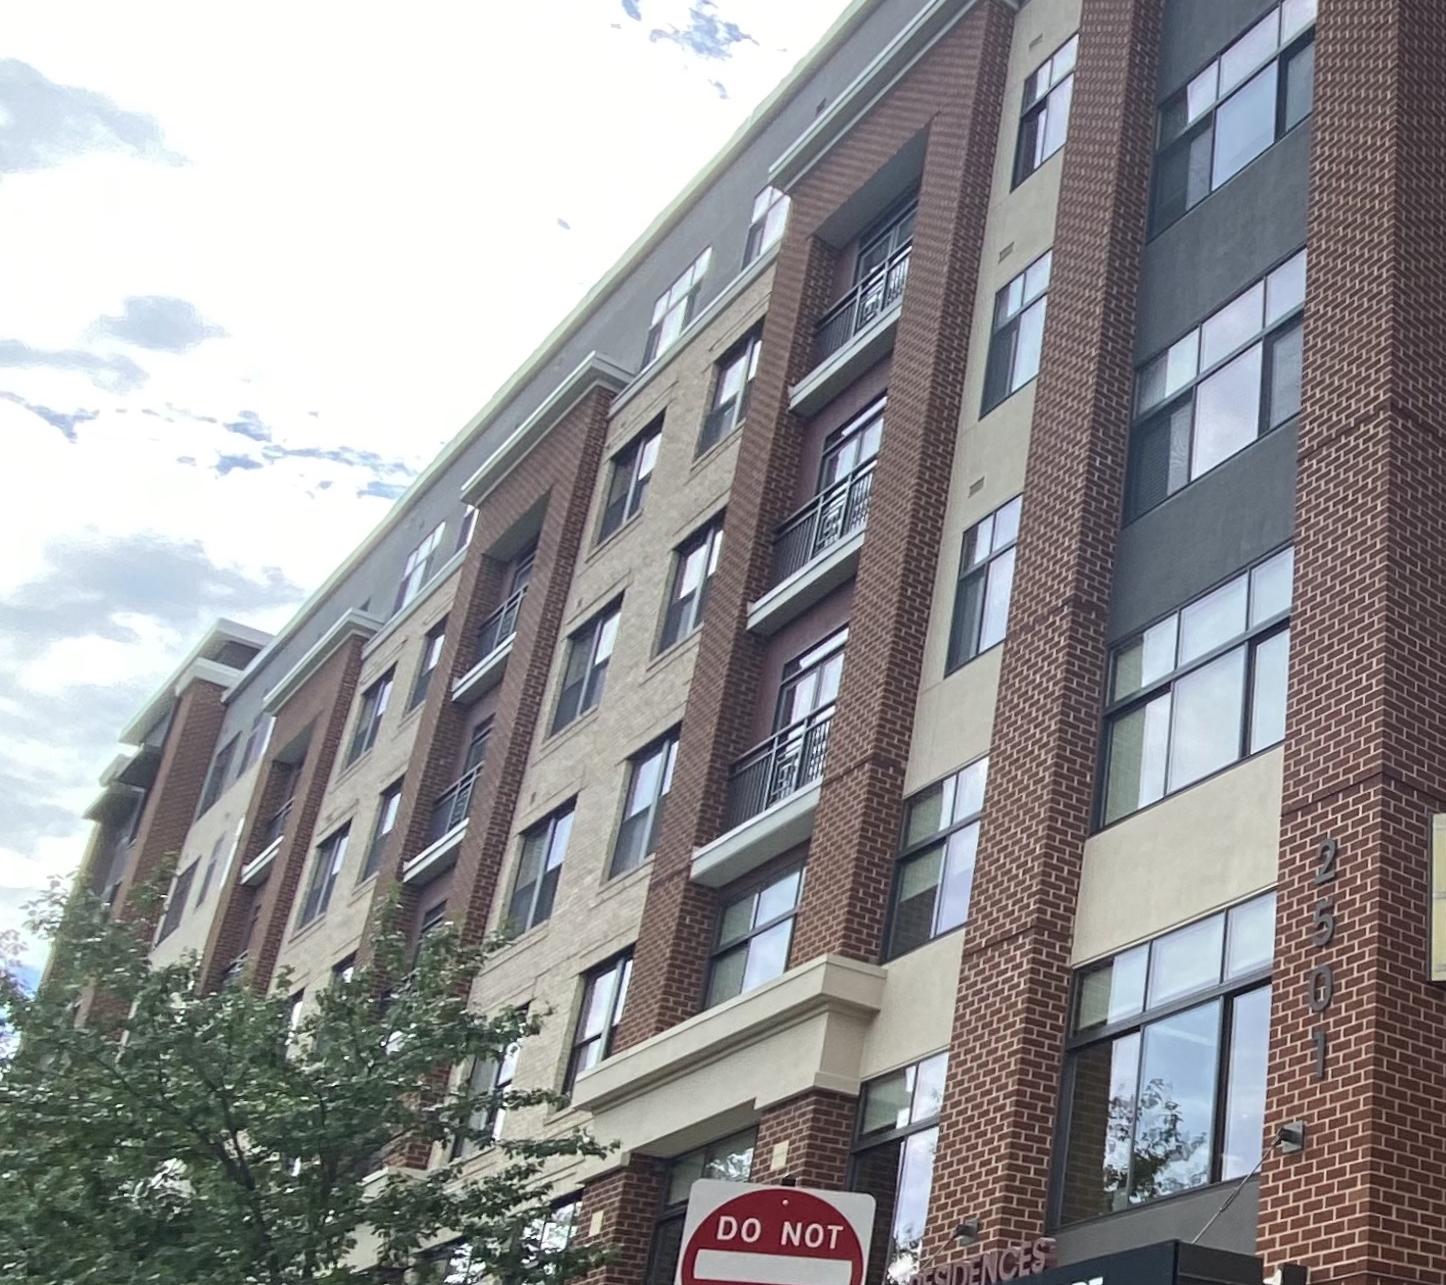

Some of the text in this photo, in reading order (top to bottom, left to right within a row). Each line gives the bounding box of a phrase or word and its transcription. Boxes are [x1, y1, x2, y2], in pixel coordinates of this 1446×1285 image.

[1309, 838, 1337, 1078] 2501
[716, 1216, 844, 1249] DO NOT
